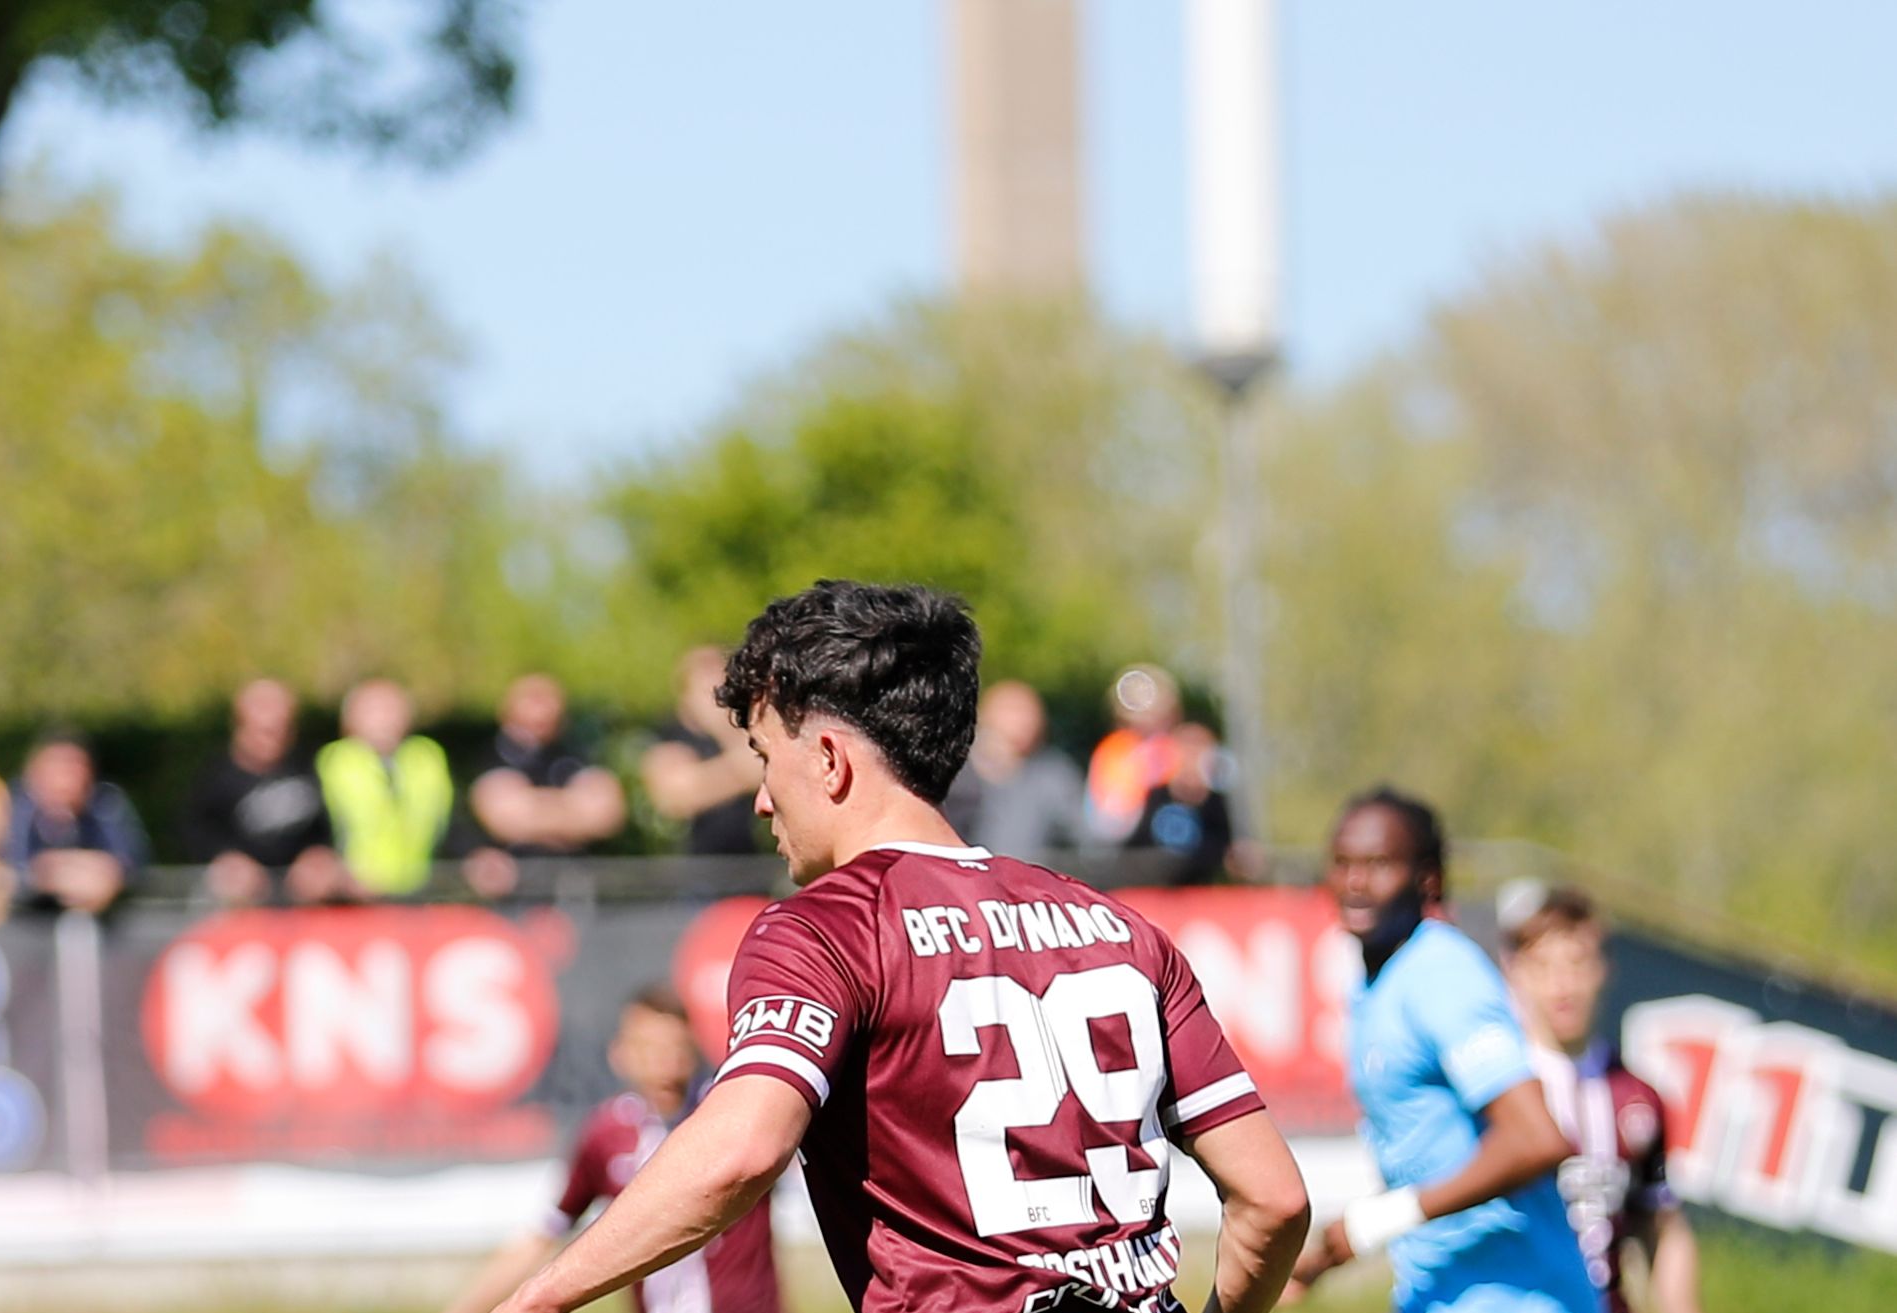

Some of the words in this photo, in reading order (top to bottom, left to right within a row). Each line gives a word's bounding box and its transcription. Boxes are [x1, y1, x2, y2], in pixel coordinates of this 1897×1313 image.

[901, 905, 983, 957] BFC
[160, 937, 530, 1098] KNS
[938, 962, 1171, 1238] 29
[1027, 1206, 1052, 1223] BFC
